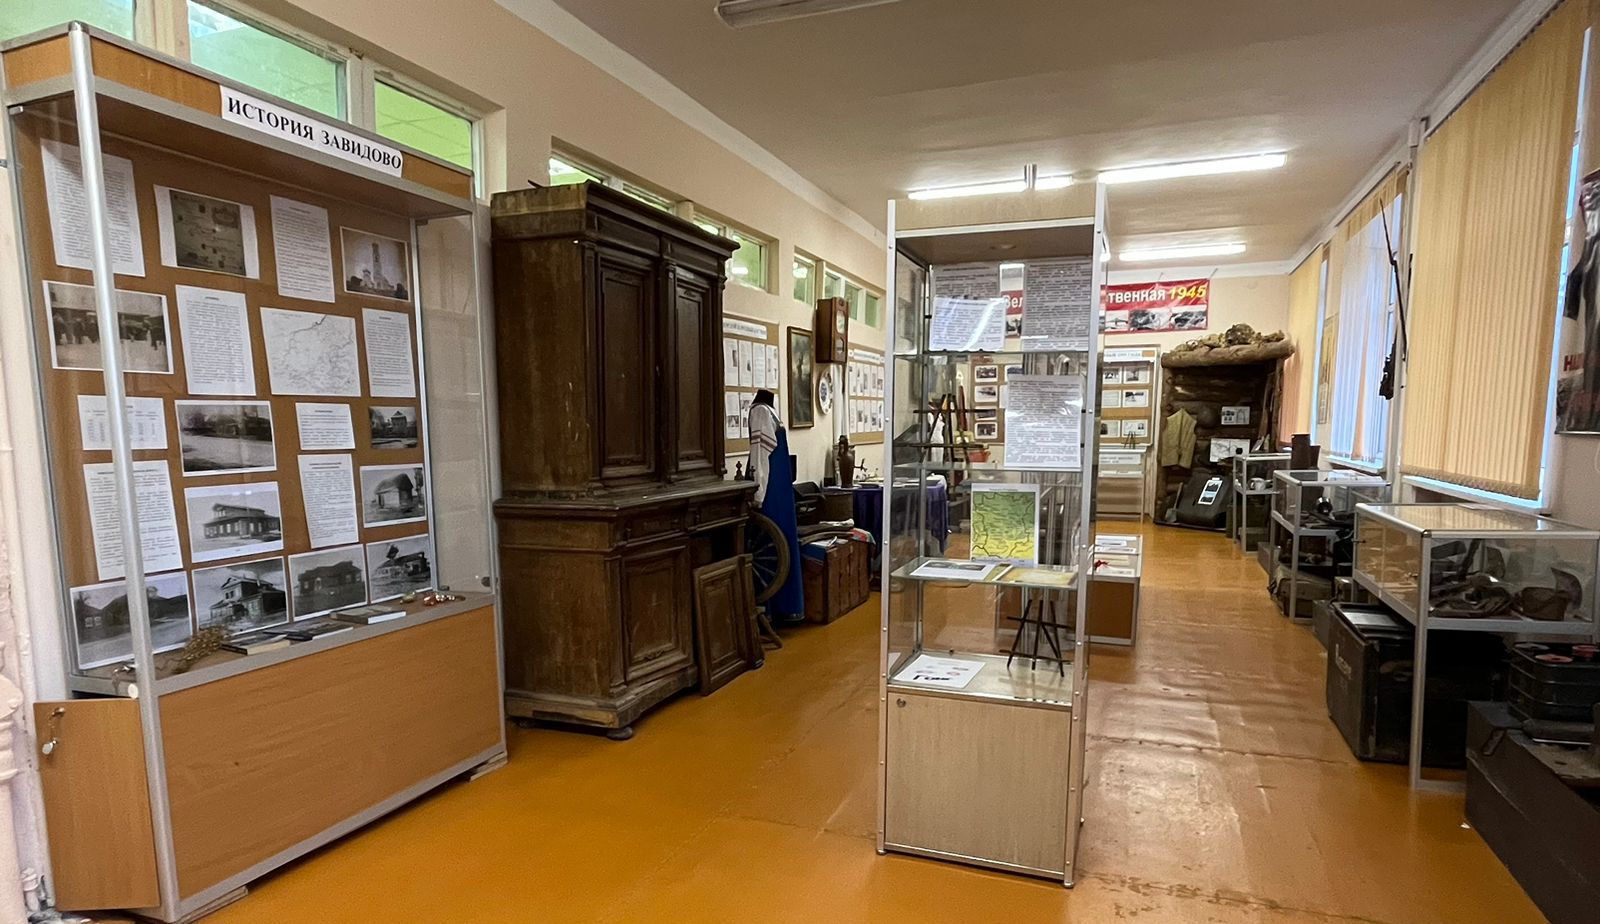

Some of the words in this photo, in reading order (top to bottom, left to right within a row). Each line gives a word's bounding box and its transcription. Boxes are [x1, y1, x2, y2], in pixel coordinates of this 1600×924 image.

[228, 97, 314, 141] ИСТОРИЯ
[321, 130, 402, 170] ЗАВИДОВО
[1169, 285, 1207, 300] 1945
